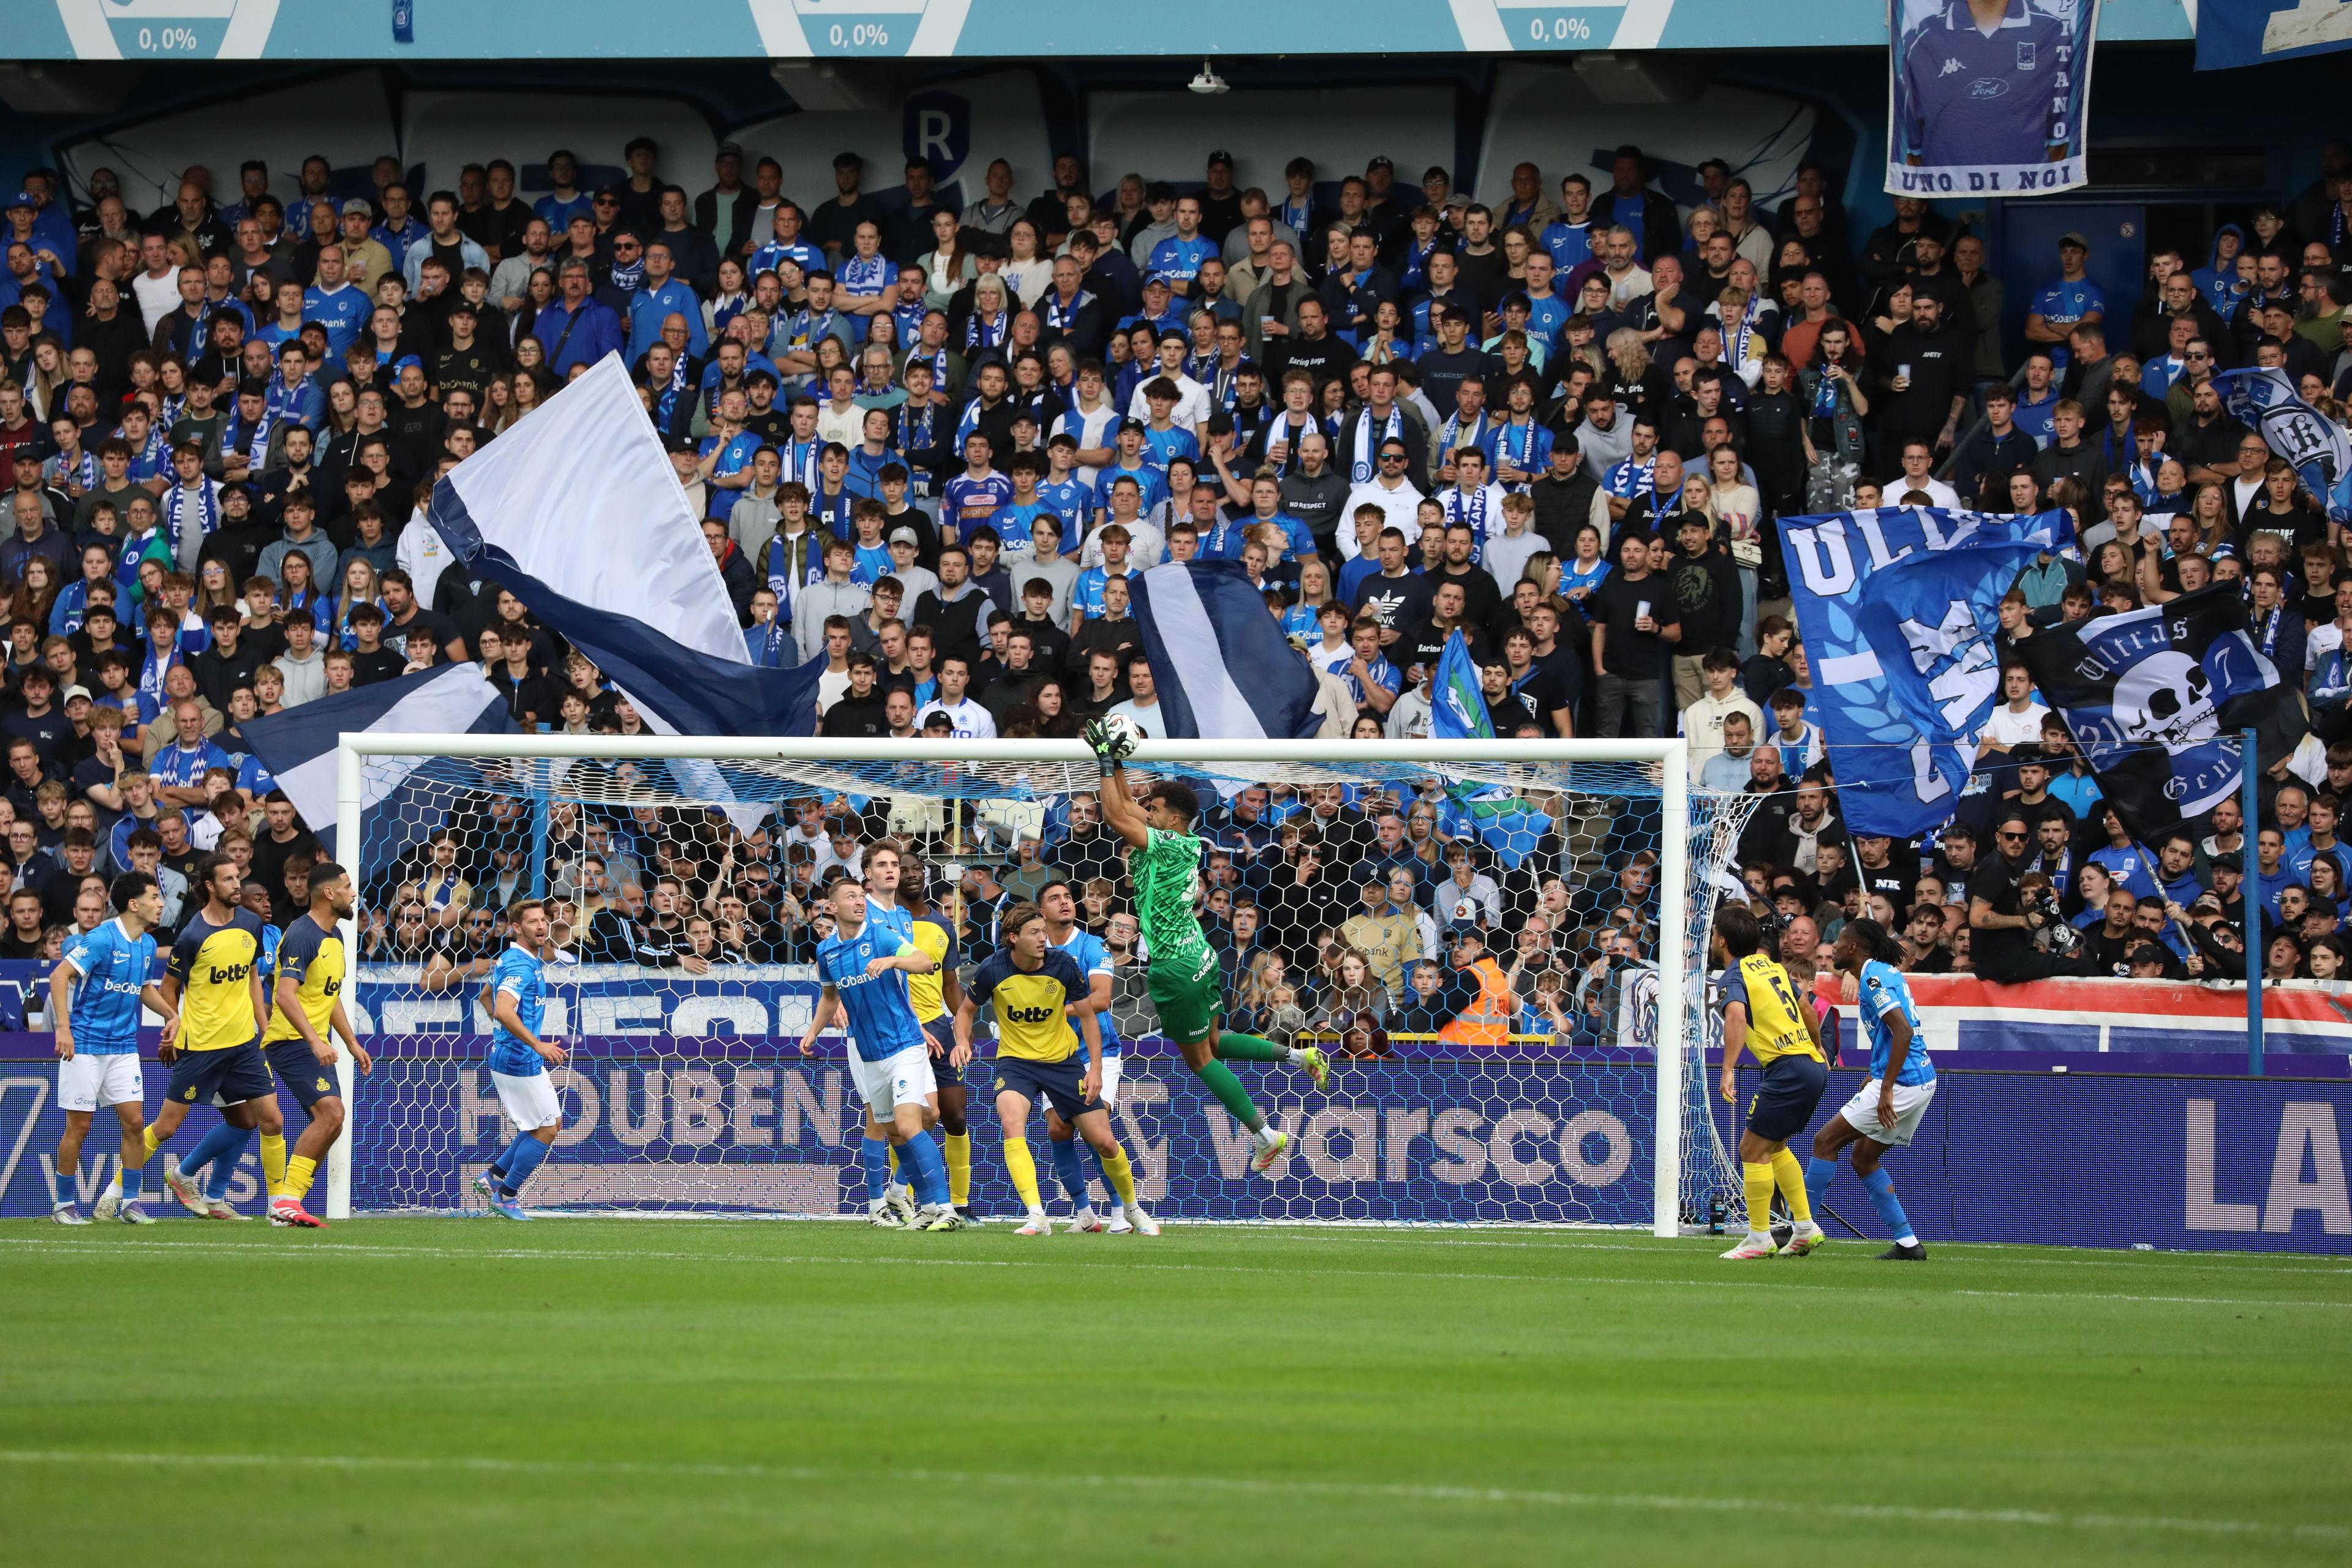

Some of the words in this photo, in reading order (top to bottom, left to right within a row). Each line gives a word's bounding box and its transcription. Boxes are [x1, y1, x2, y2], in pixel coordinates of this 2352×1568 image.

[1972, 80, 2002, 96] Ford
[919, 111, 954, 160] R
[1902, 172, 1953, 192] UNO
[1969, 172, 2000, 190] DI
[2019, 165, 2070, 190] NOI
[1289, 356, 1309, 367] Racing
[2075, 617, 2188, 680] Ultras
[1875, 878, 1901, 891] NK
[1768, 976, 1800, 1023] 5
[459, 1069, 841, 1147] HOUBEN
[1204, 1105, 1632, 1186] warsco
[2185, 1099, 2351, 1234] LA
